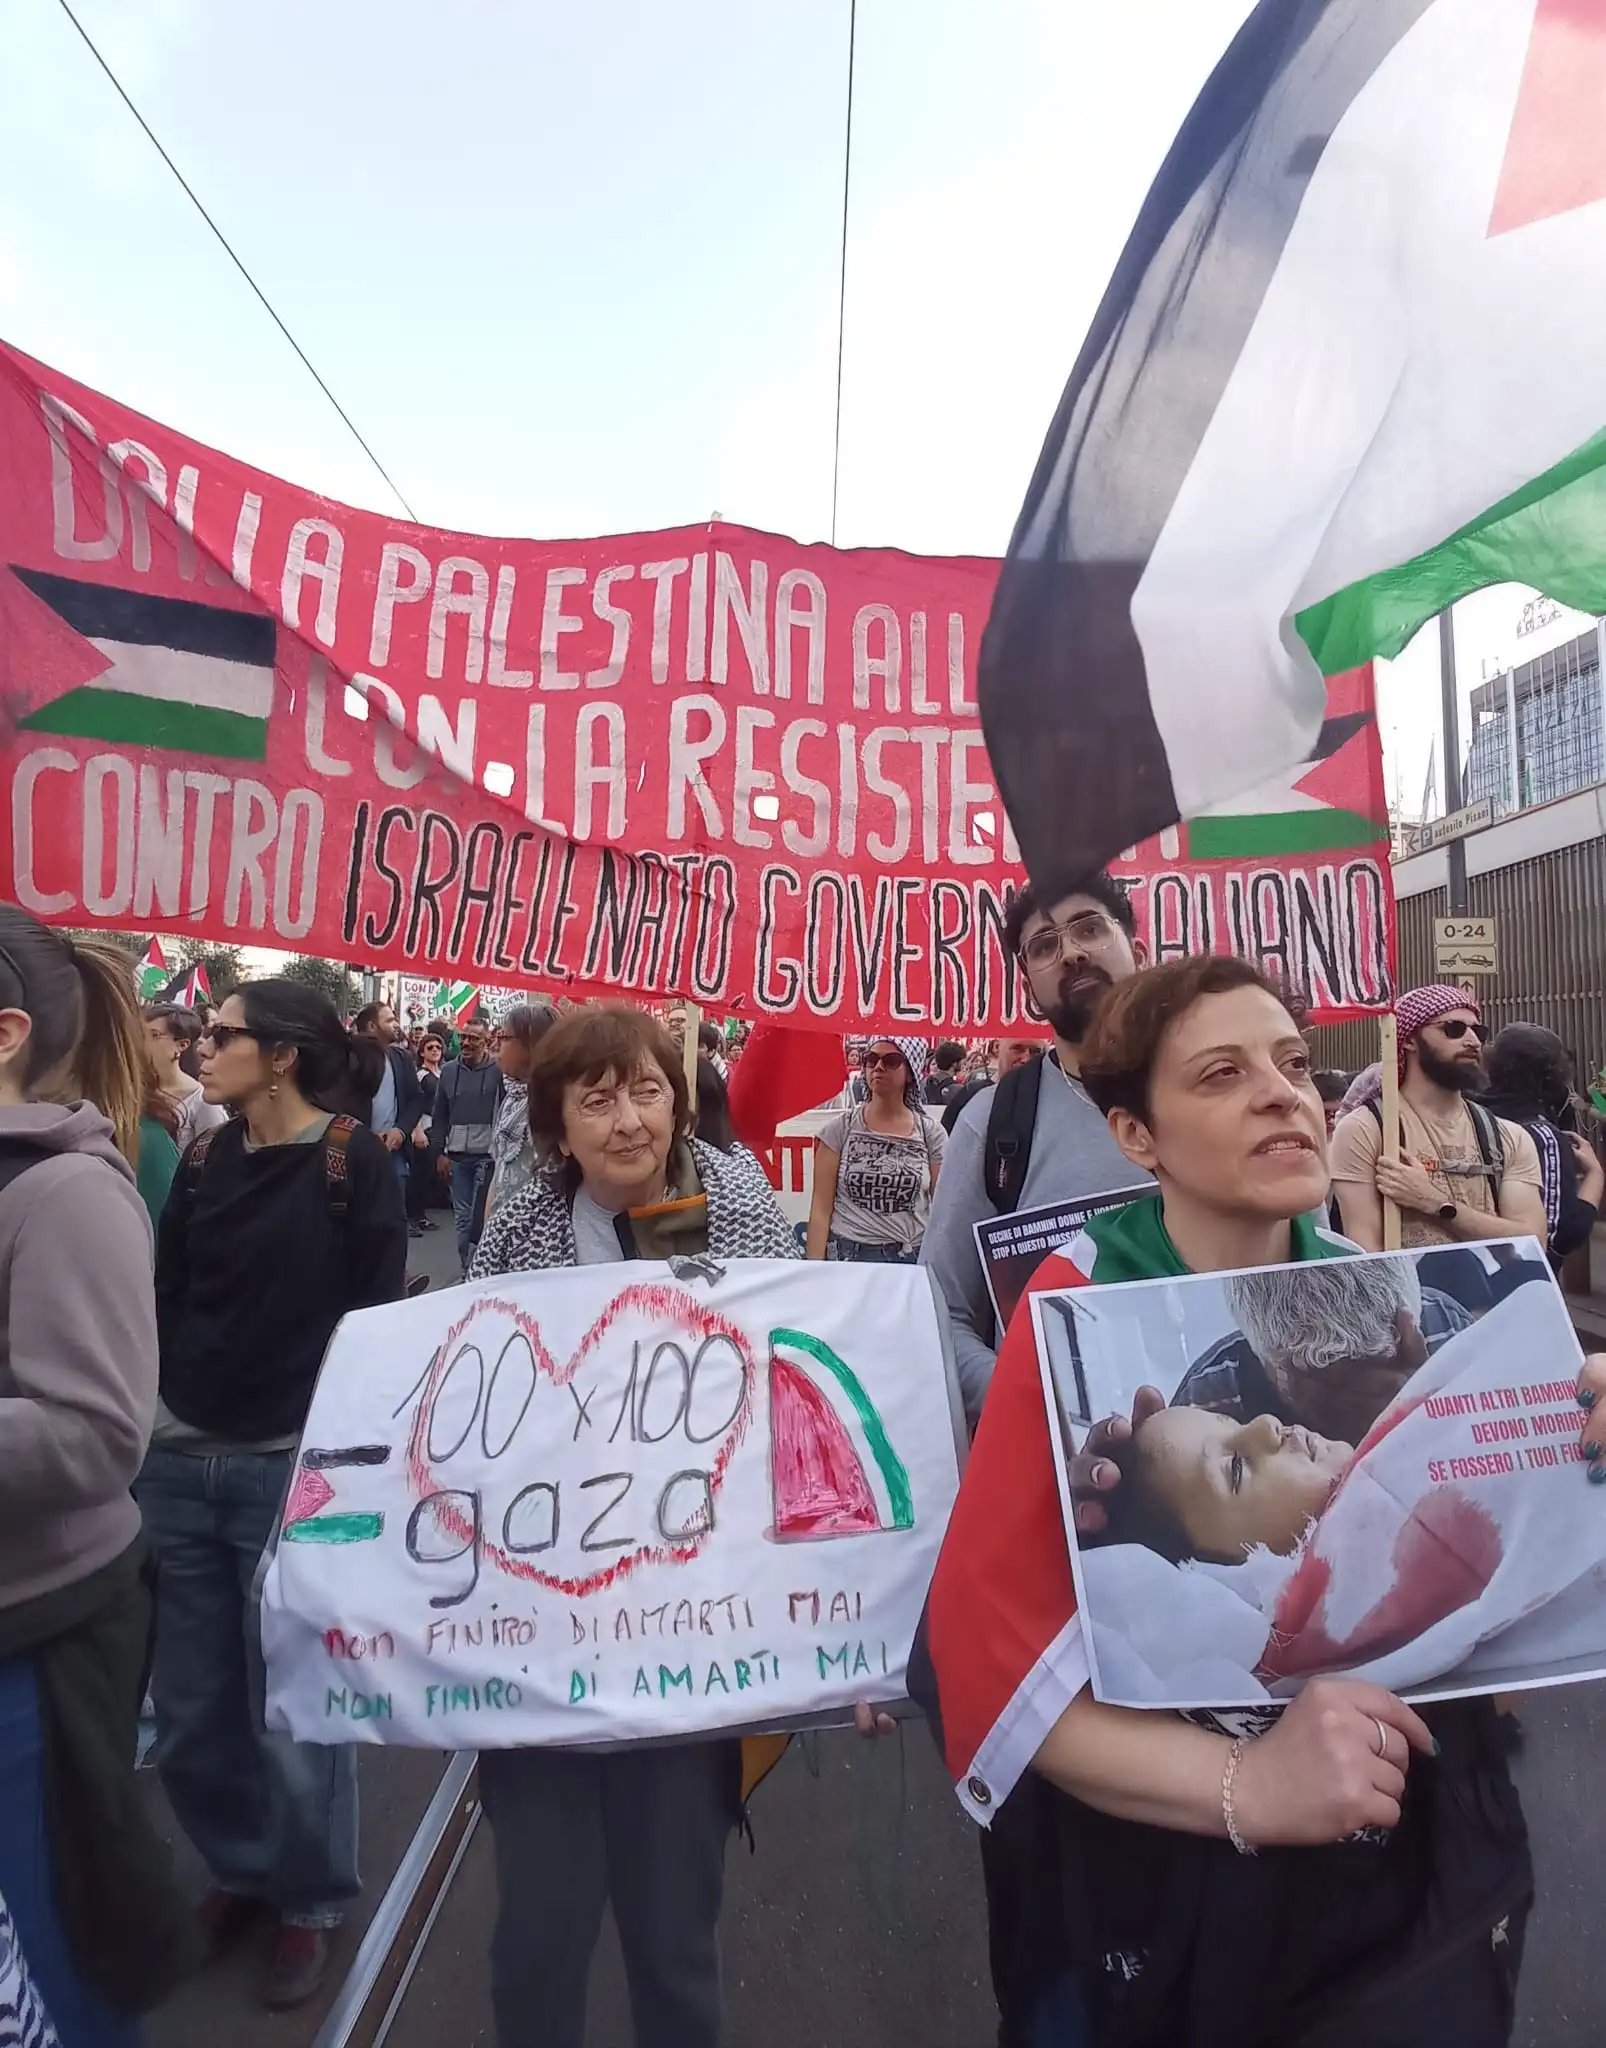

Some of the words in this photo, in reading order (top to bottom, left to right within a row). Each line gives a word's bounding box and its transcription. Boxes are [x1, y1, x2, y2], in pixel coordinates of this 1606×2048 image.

[369, 542, 827, 704] PALESTINA
[526, 702, 626, 839] LA
[1434, 818, 1463, 839] autosilo
[1465, 805, 1489, 825] Pisani
[11, 748, 325, 939] CONTRO
[753, 864, 1050, 1027] GOVERN
[1444, 924, 1486, 938] 0-24
[847, 1172, 915, 1187] RADIO
[848, 1186, 913, 1200] BLACK
[992, 1245, 1010, 1261] STOP
[1010, 1244, 1018, 1256] A
[1017, 1237, 1047, 1254] QUESTO
[1013, 1225, 1022, 1239] DI
[1424, 1392, 1478, 1419] QUANTI
[1479, 1386, 1520, 1412] ALTRI
[1471, 1417, 1529, 1444] DEVONO
[1428, 1460, 1448, 1482] SE
[1449, 1452, 1514, 1479] FOSSERO
[1517, 1450, 1524, 1470] I
[1525, 1445, 1558, 1469] TUOI
[405, 1468, 716, 1609] gaza
[569, 1610, 599, 1645] DI
[614, 1593, 754, 1642] AMARTI
[788, 1588, 862, 1626] MAI
[325, 1687, 393, 1720] NON
[633, 1649, 780, 1698] AMARTI
[816, 1640, 888, 1681] MAI
